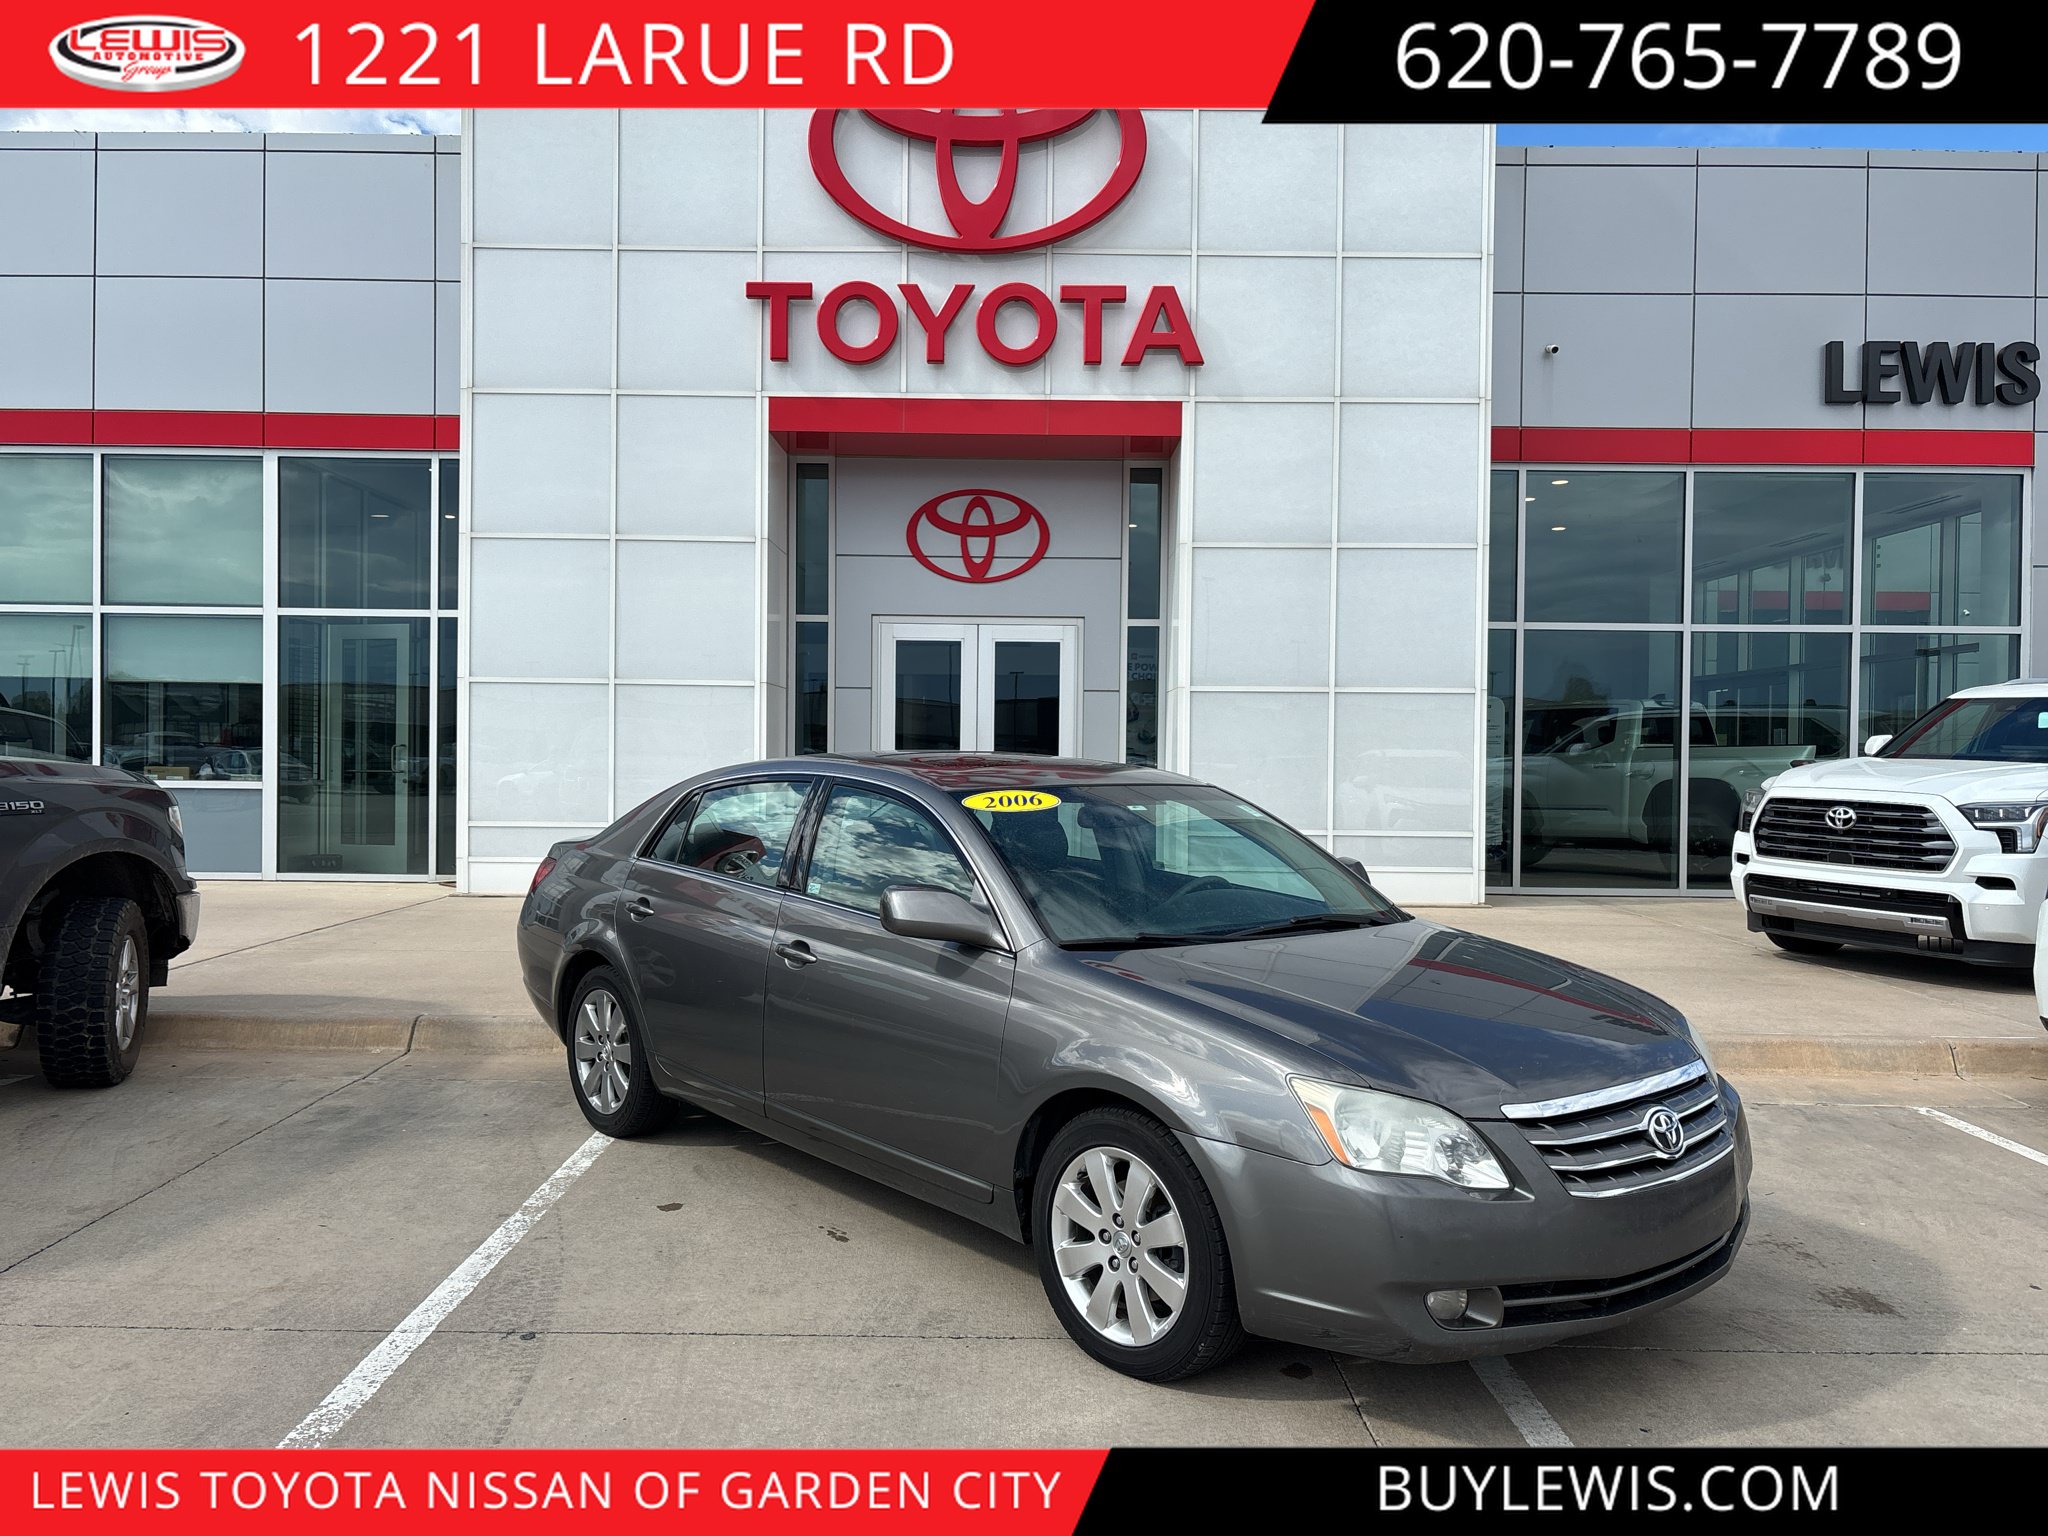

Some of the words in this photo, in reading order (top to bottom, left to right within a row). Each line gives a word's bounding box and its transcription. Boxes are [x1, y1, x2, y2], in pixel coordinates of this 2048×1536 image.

[746, 281, 1203, 365] TOYOTA
[1825, 340, 2041, 405] LEWIS
[983, 793, 1043, 809] 2006
